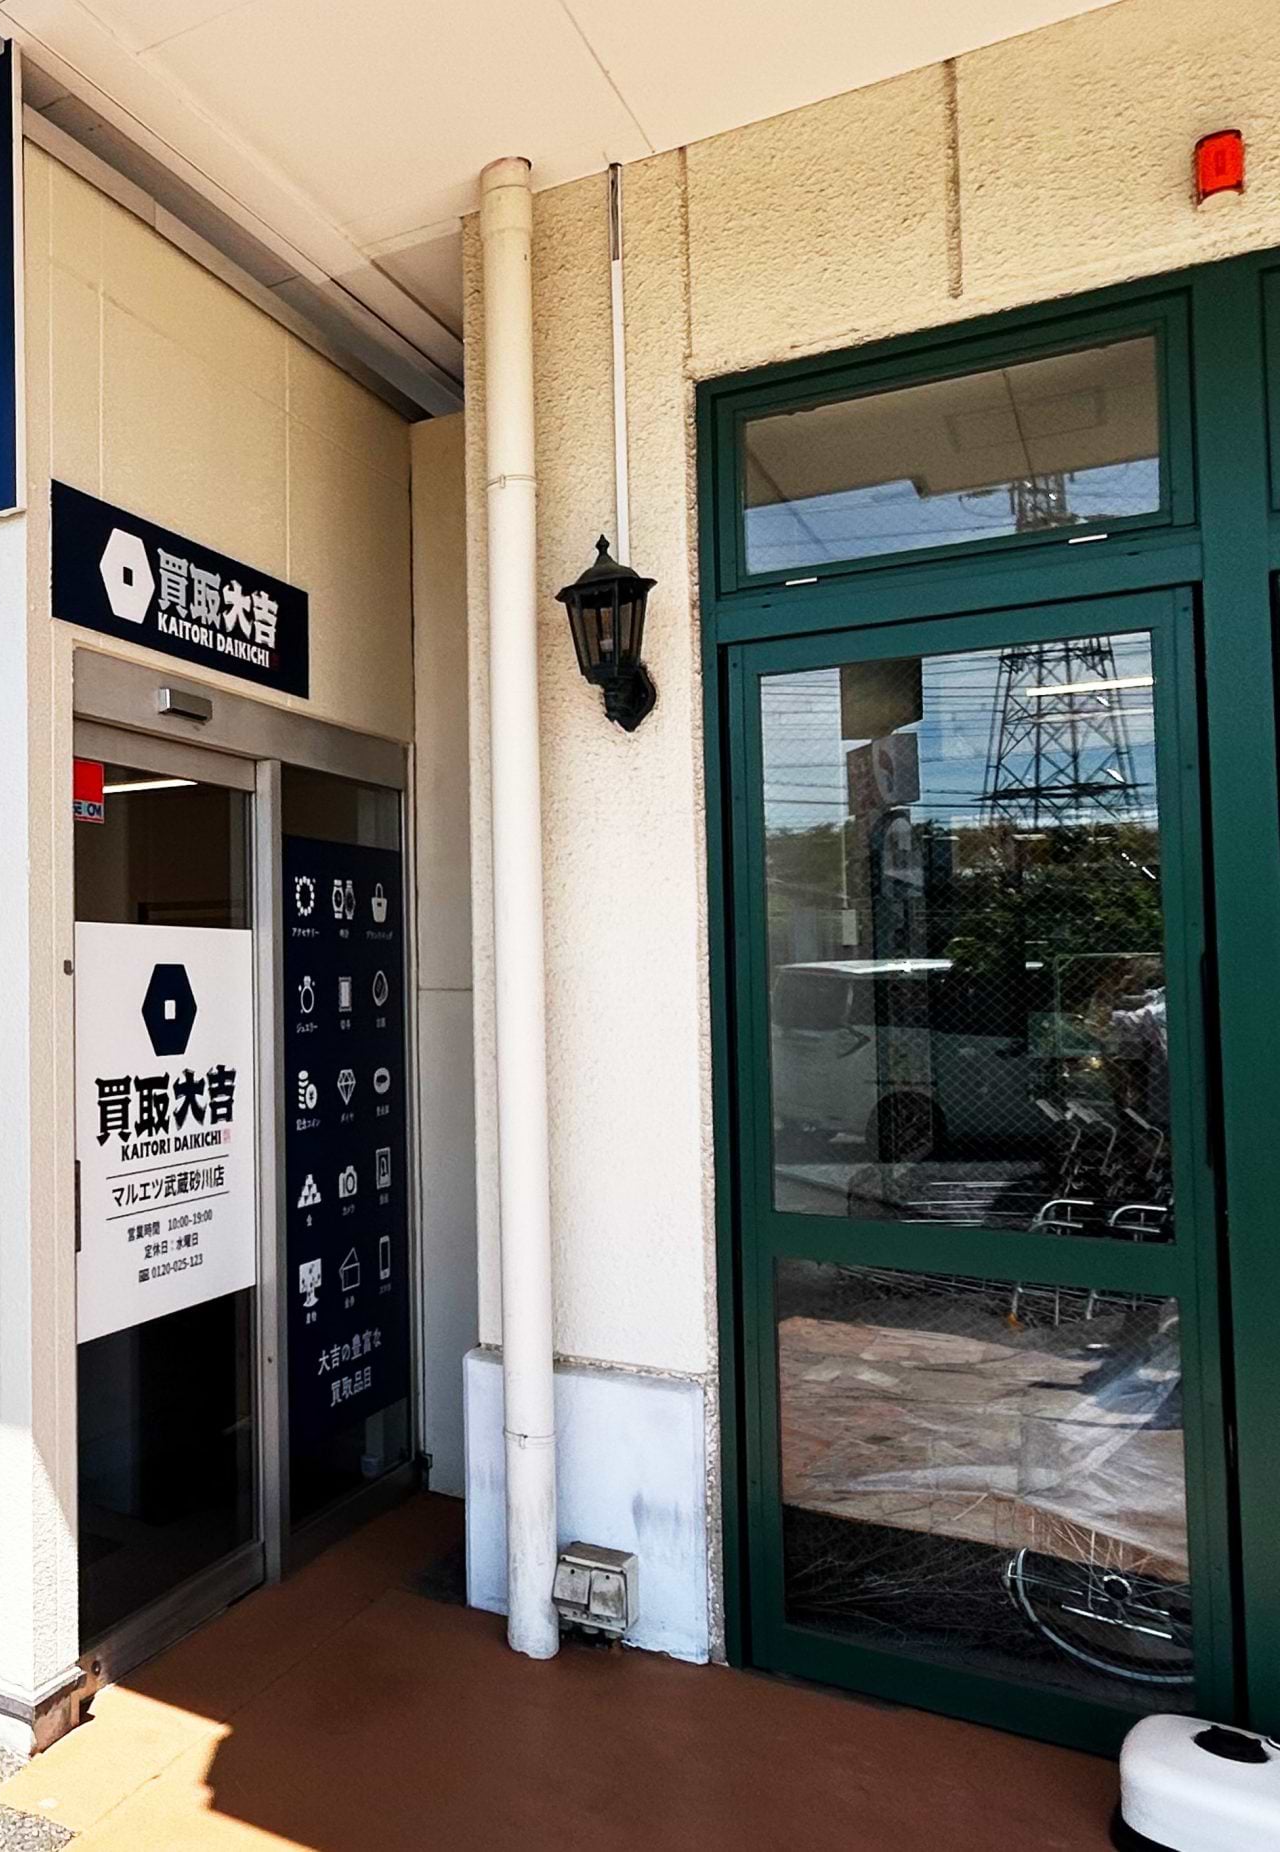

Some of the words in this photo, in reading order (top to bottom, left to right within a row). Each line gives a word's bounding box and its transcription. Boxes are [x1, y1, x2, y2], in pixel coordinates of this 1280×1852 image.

[157, 547, 279, 649] 買取大吉
[157, 611, 214, 649] KAITORI
[216, 634, 270, 669] DAIKICHI
[95, 1064, 236, 1147] 買取大吉
[121, 1137, 171, 1162] KAITORI
[174, 1129, 222, 1153] DAIKICHI
[111, 1164, 225, 1208] マルエツ武蔵砂川店
[127, 1220, 161, 1243] 営業時間
[167, 1208, 213, 1232] 10:00-19:00
[151, 1253, 204, 1279] 0120-025-123
[317, 1327, 382, 1376] 大吉の豊富な
[330, 1366, 372, 1408] 買取品目
